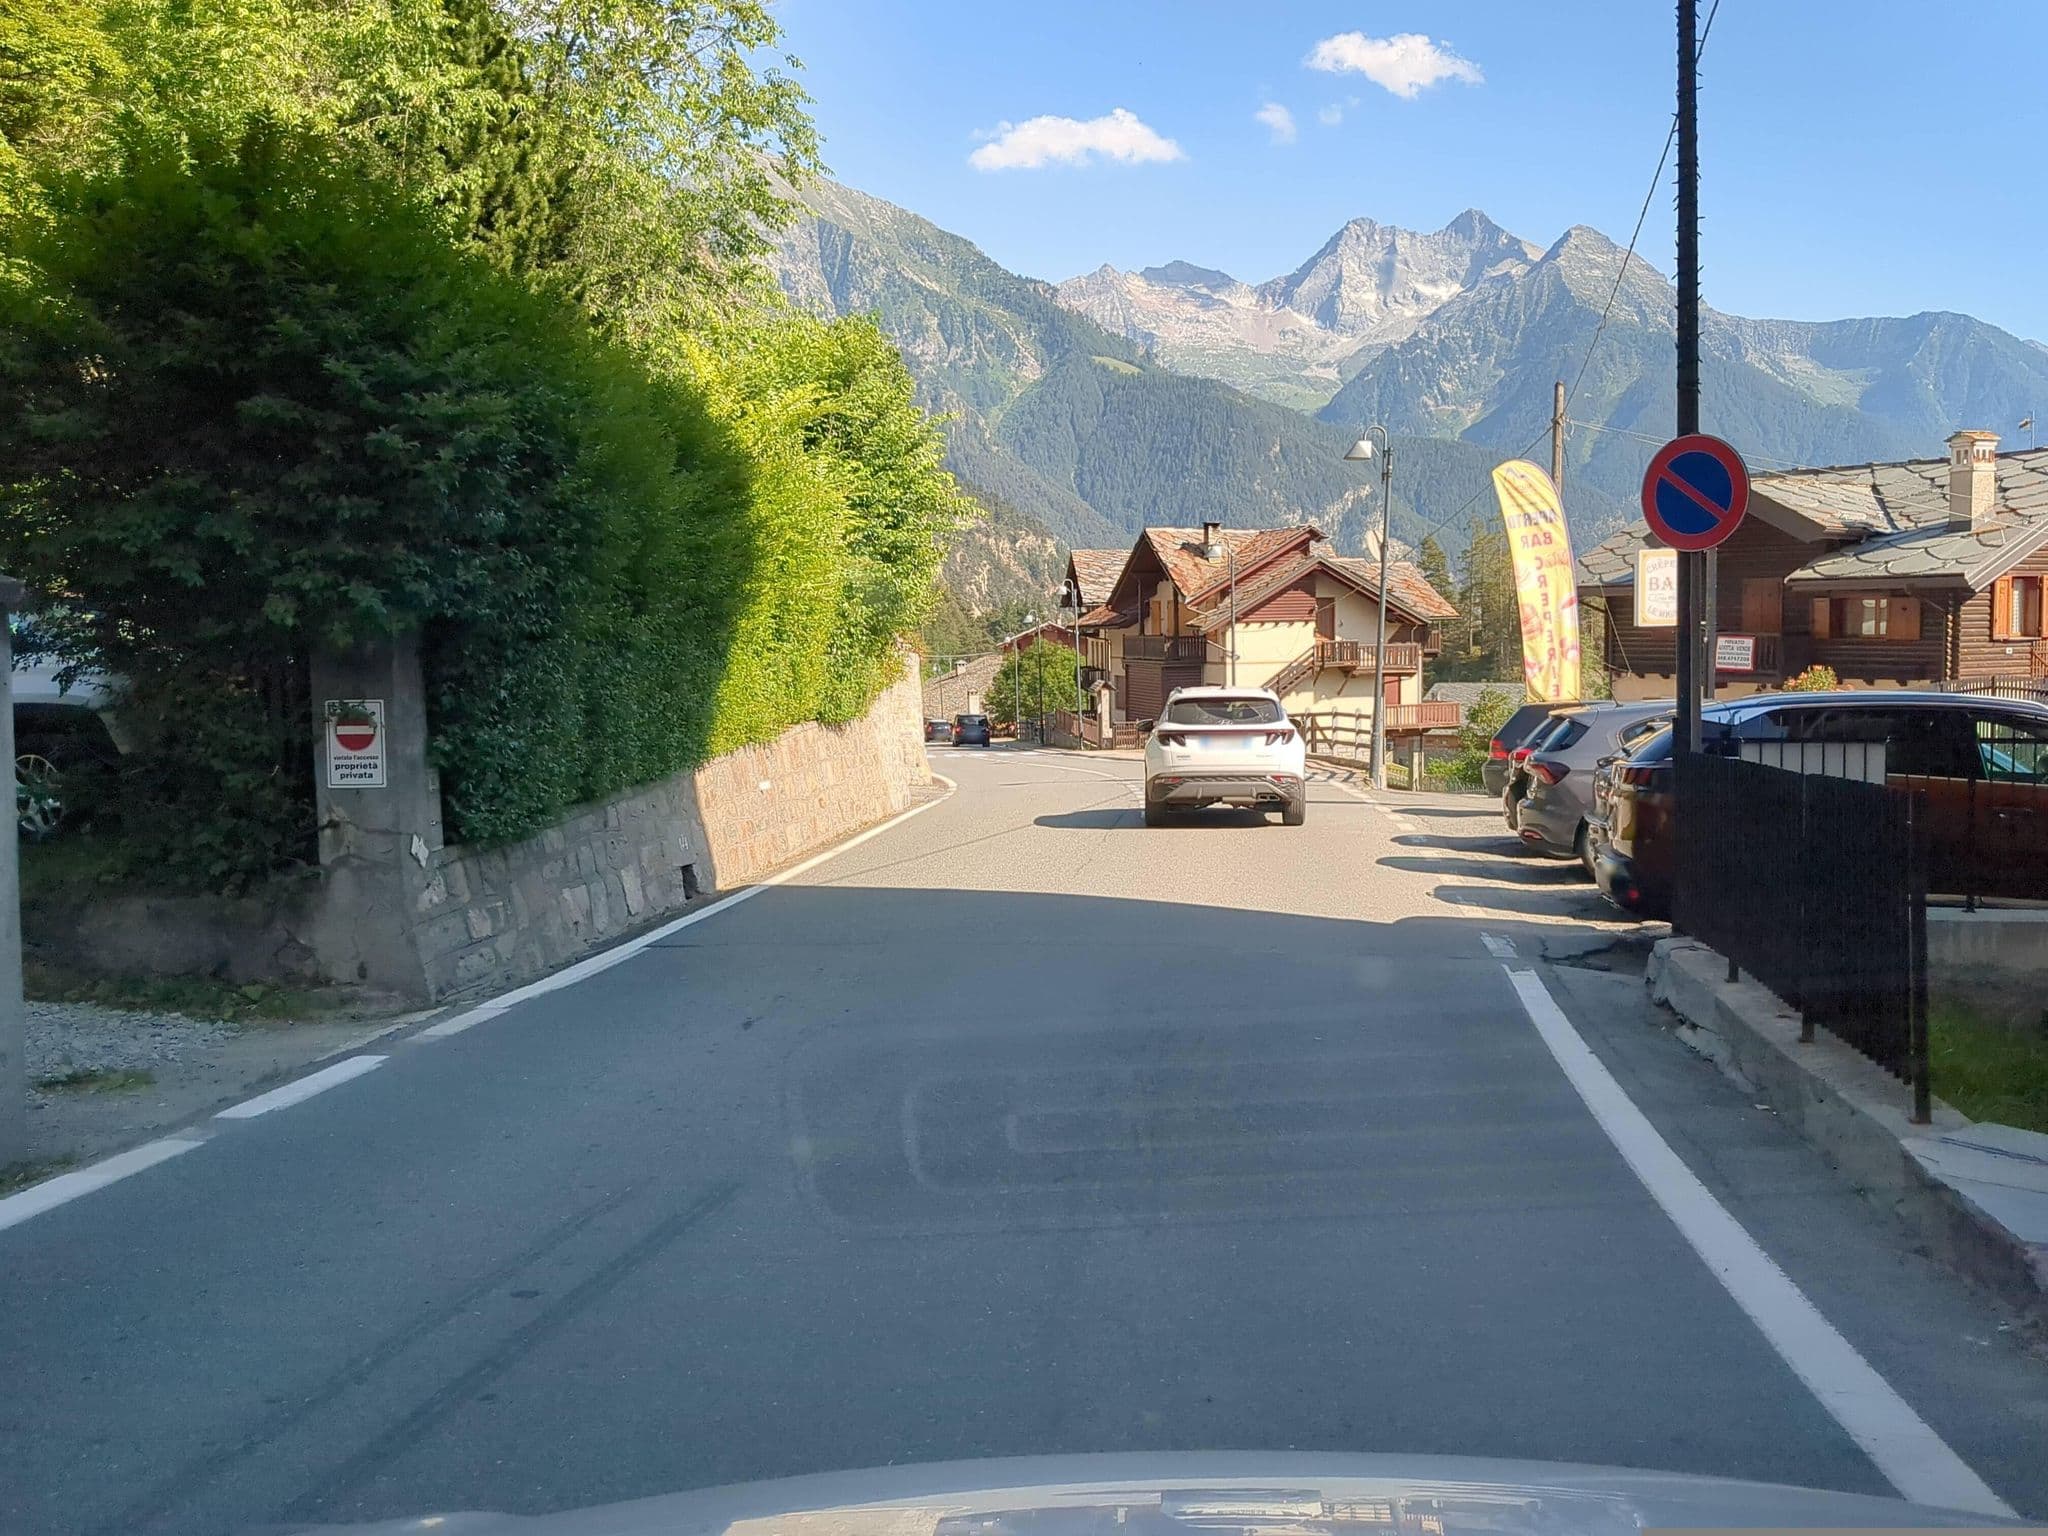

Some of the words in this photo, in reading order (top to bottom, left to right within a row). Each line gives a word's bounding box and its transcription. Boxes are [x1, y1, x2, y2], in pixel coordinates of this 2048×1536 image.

[1648, 576, 1675, 591] BA
[335, 761, 377, 770] proprietà
[340, 772, 373, 780] privata
